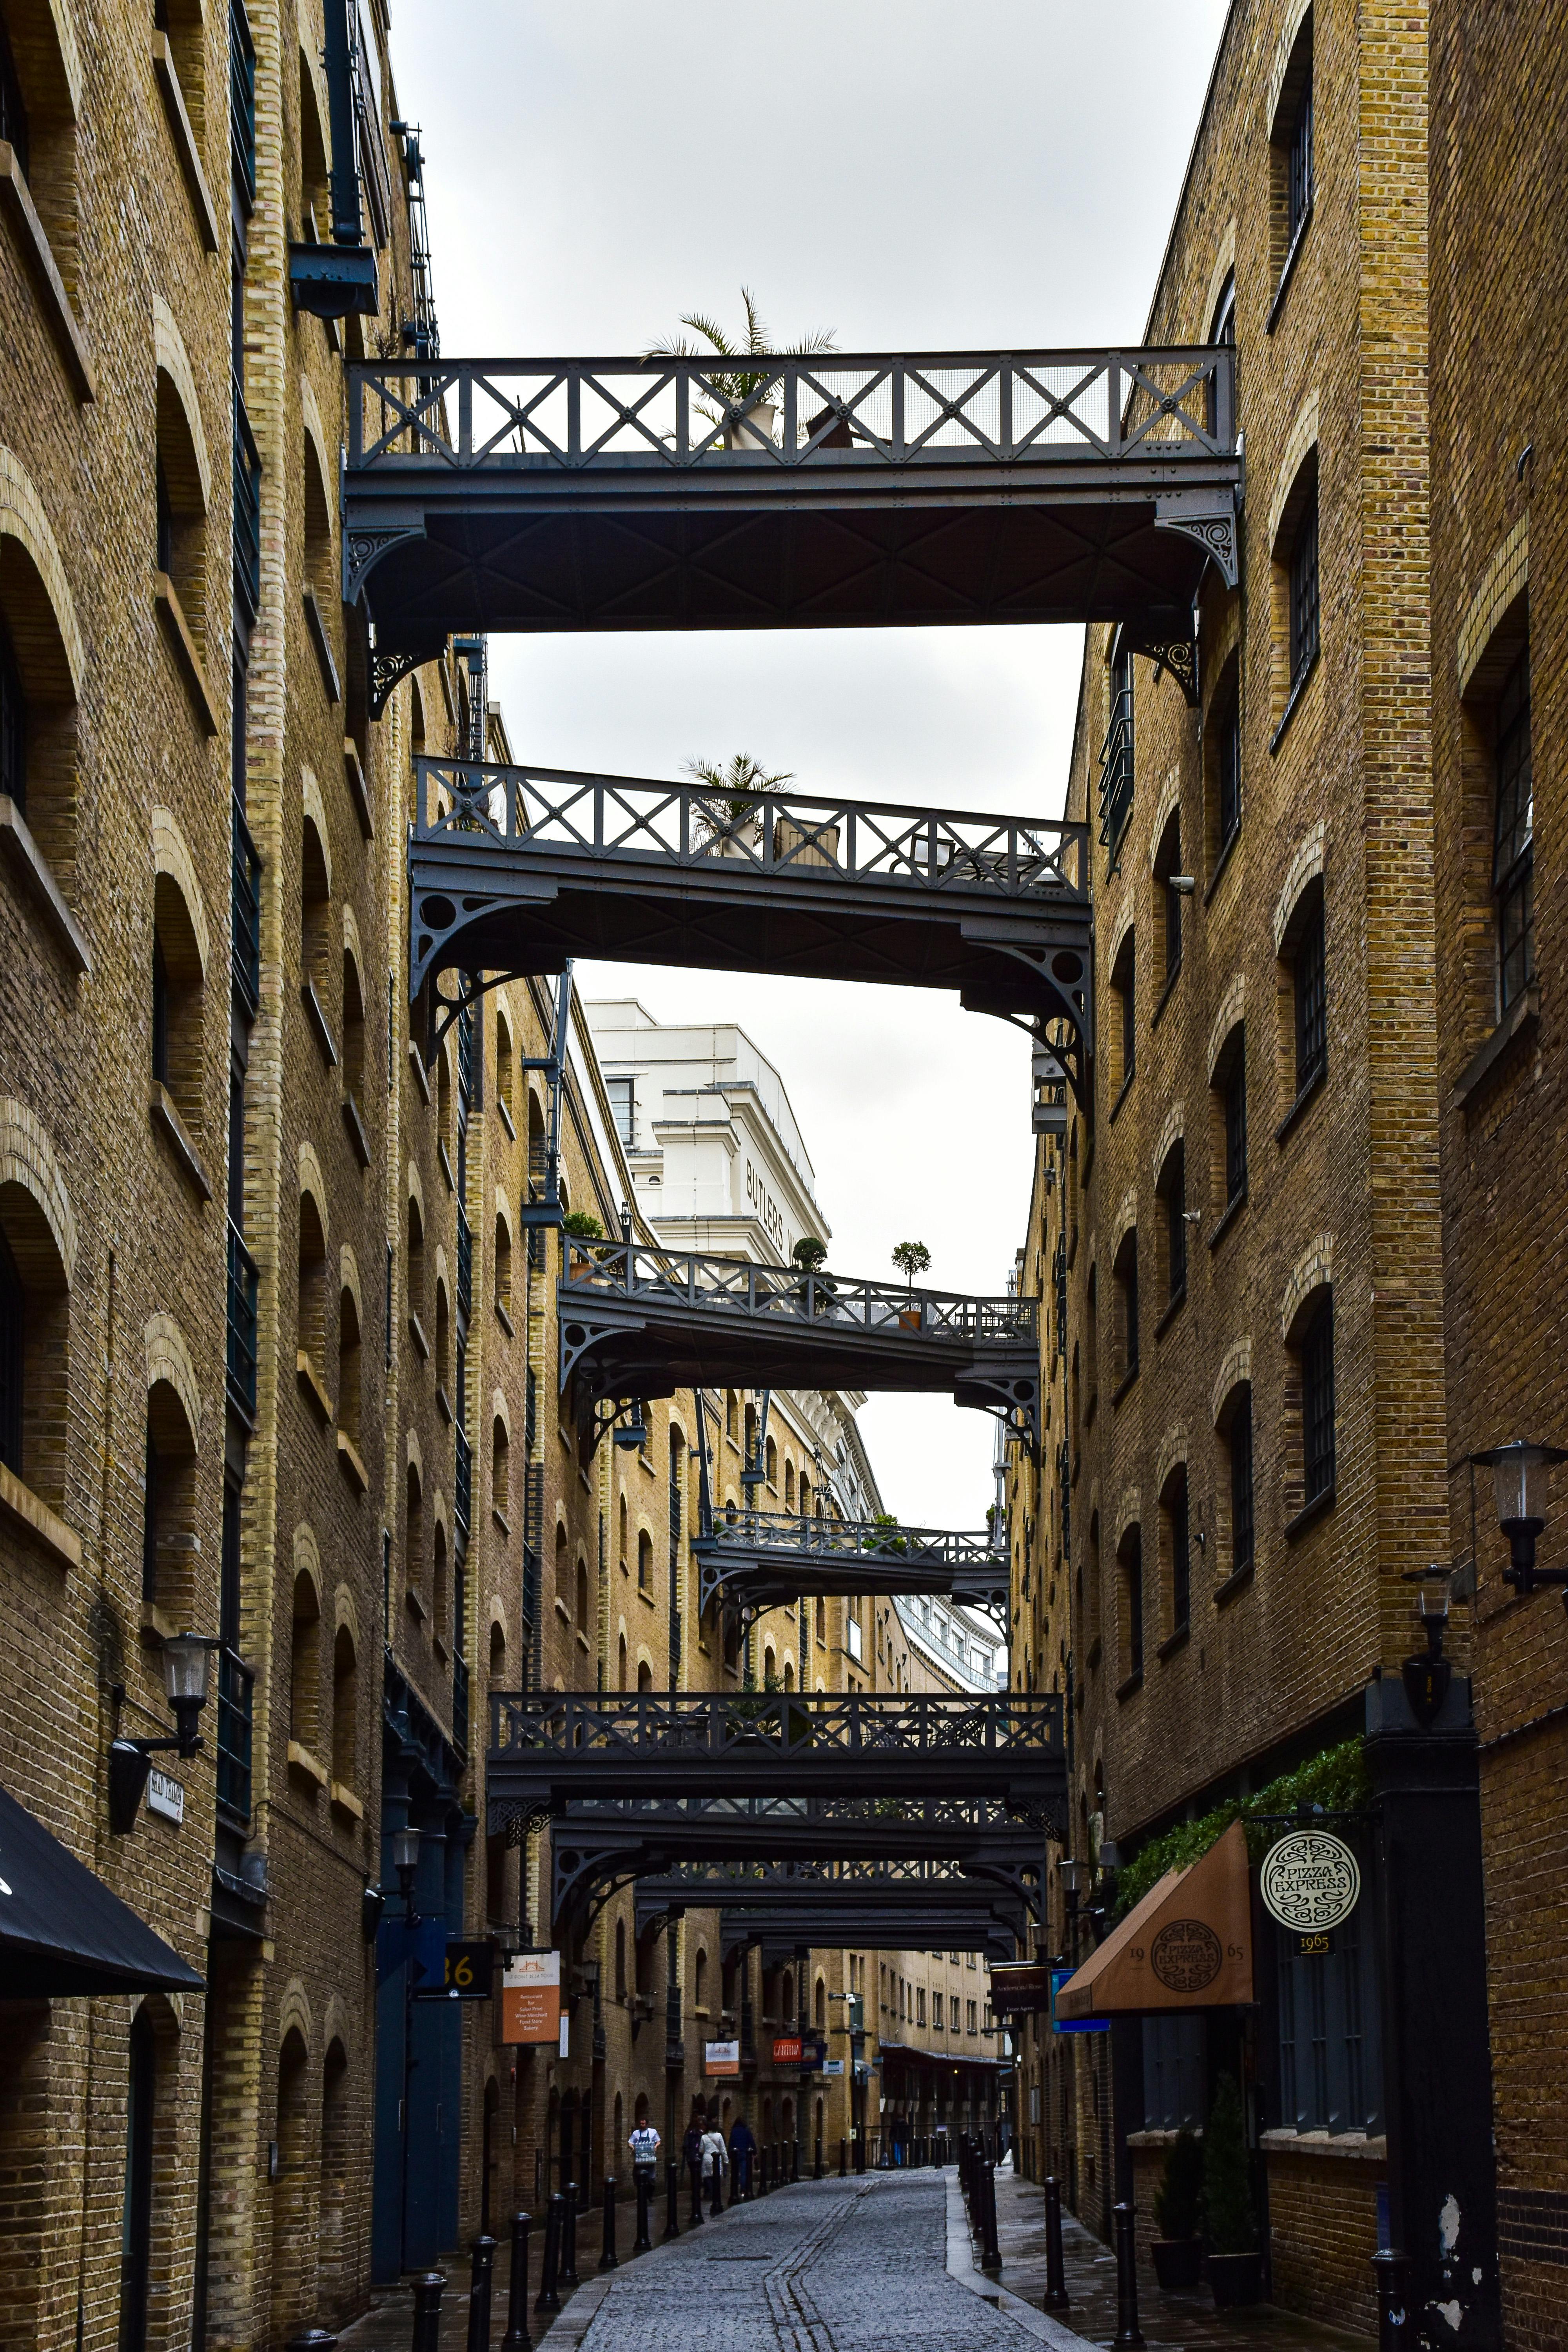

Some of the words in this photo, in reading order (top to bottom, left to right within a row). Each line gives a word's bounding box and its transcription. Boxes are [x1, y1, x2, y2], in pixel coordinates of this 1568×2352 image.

[747, 1158, 783, 1251] BUTLERS
[152, 1771, 164, 1795] SHAD
[165, 1779, 181, 1806] THAMES
[1287, 1866, 1333, 1880] PIZZA
[1274, 1877, 1347, 1892] EXPRESS
[1300, 1934, 1329, 1951] 1965
[1129, 1948, 1144, 1961] 19
[1169, 1945, 1203, 1955] PIZZA
[1228, 1943, 1243, 1960] 65
[1159, 1953, 1214, 1964] EXPRESS
[774, 2044, 800, 2056] CANTINA
